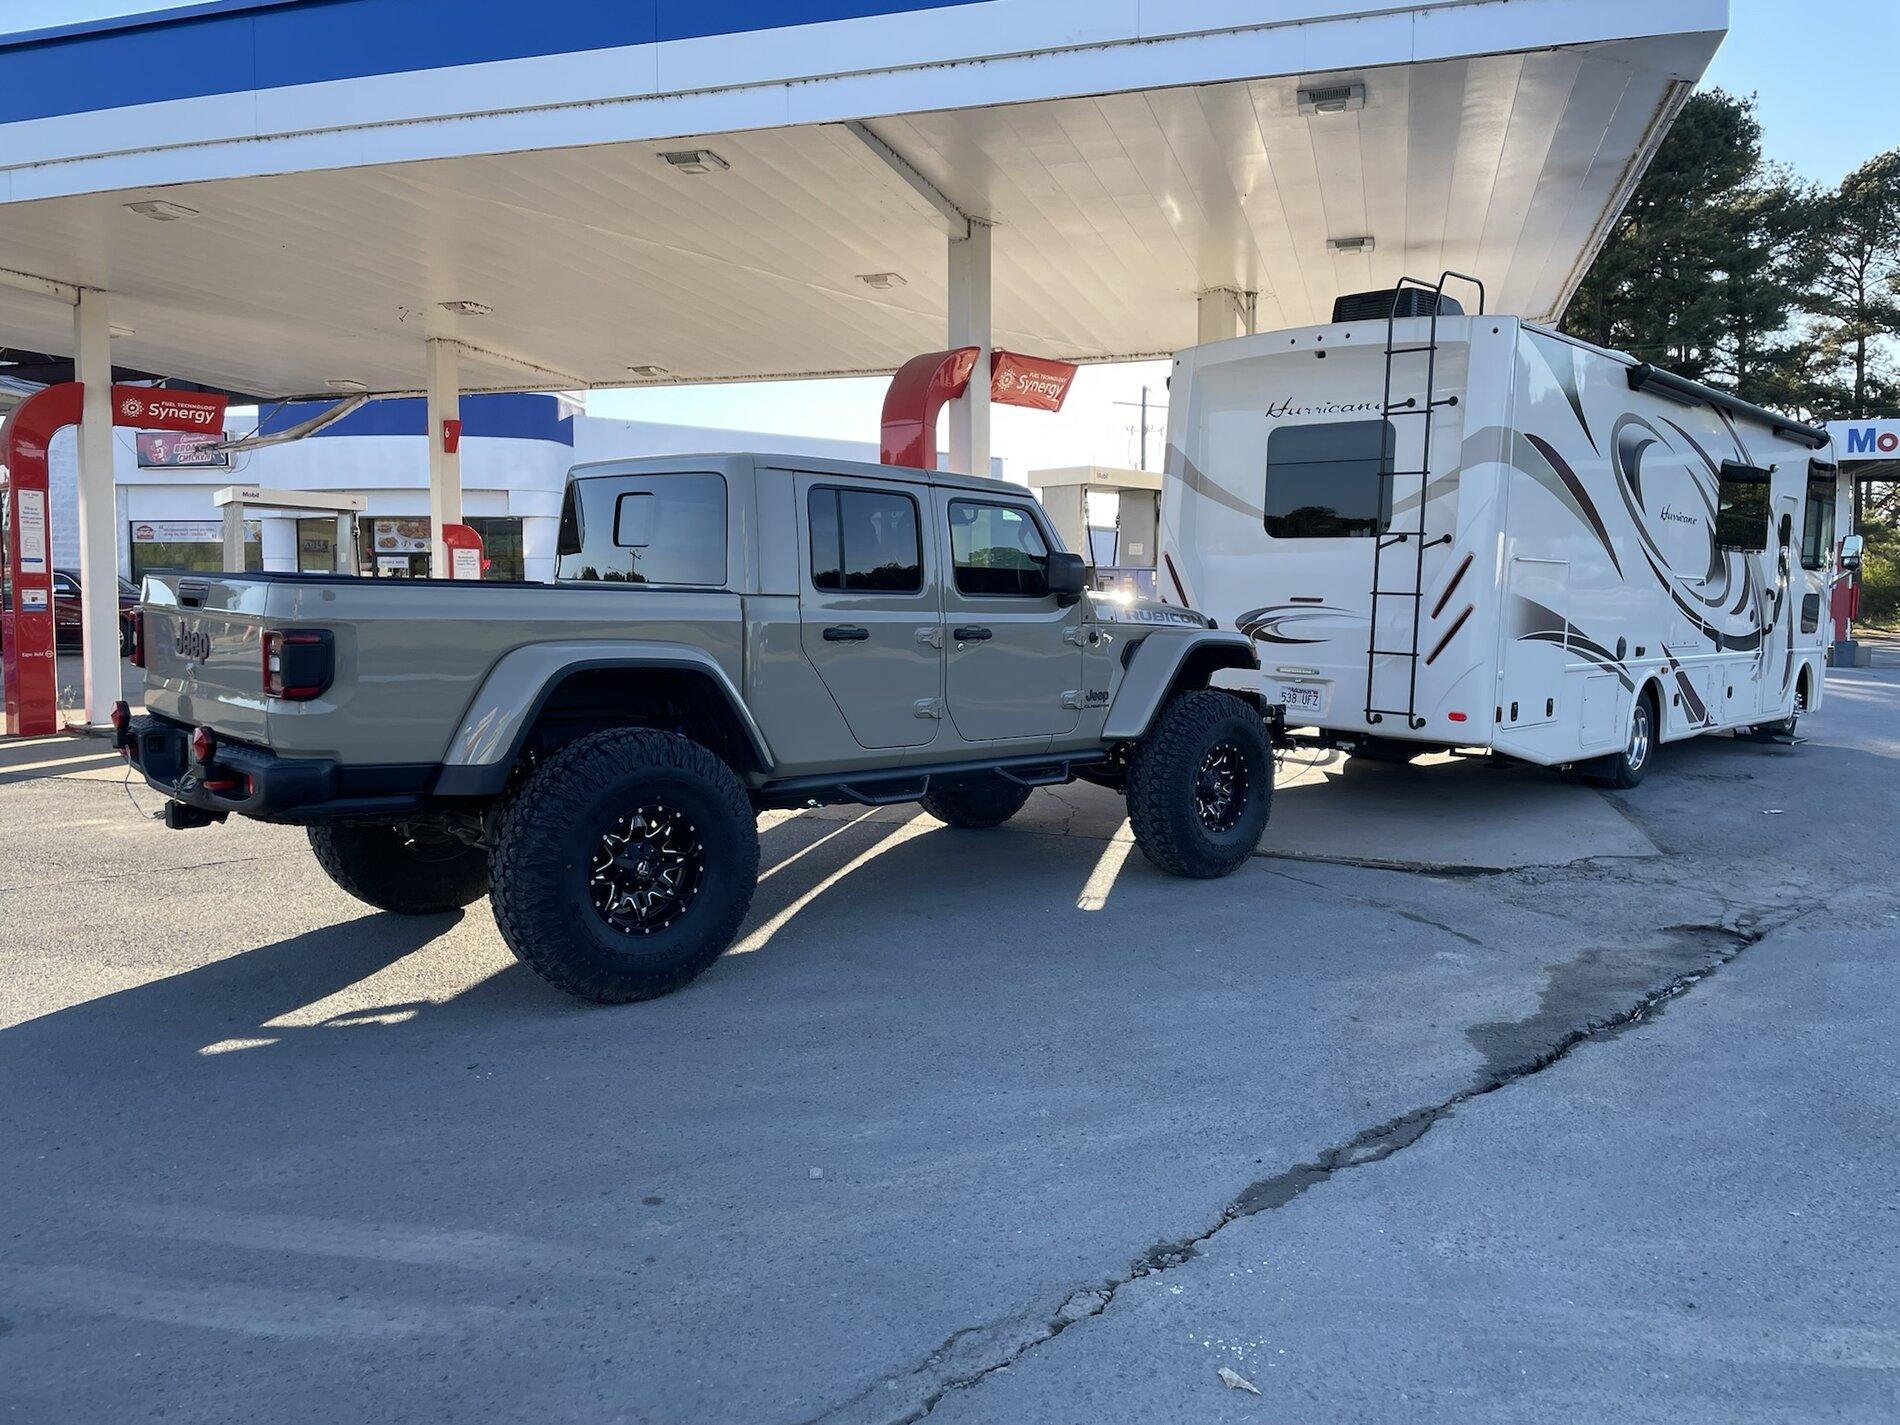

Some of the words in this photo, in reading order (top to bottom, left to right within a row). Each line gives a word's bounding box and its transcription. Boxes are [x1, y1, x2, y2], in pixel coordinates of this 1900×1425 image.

[1017, 374, 1064, 400] Synergy
[148, 403, 215, 424] Synergy
[177, 402, 217, 411] TECHNOLOGY
[444, 427, 451, 438] 6
[242, 490, 261, 499] Mobil
[1660, 503, 1698, 525] Hurricane
[1124, 608, 1203, 626] RUBICON
[176, 621, 211, 665] Jeep
[1085, 689, 1109, 702] Jeep
[1281, 691, 1298, 704] 538
[1302, 694, 1319, 706] UFZ
